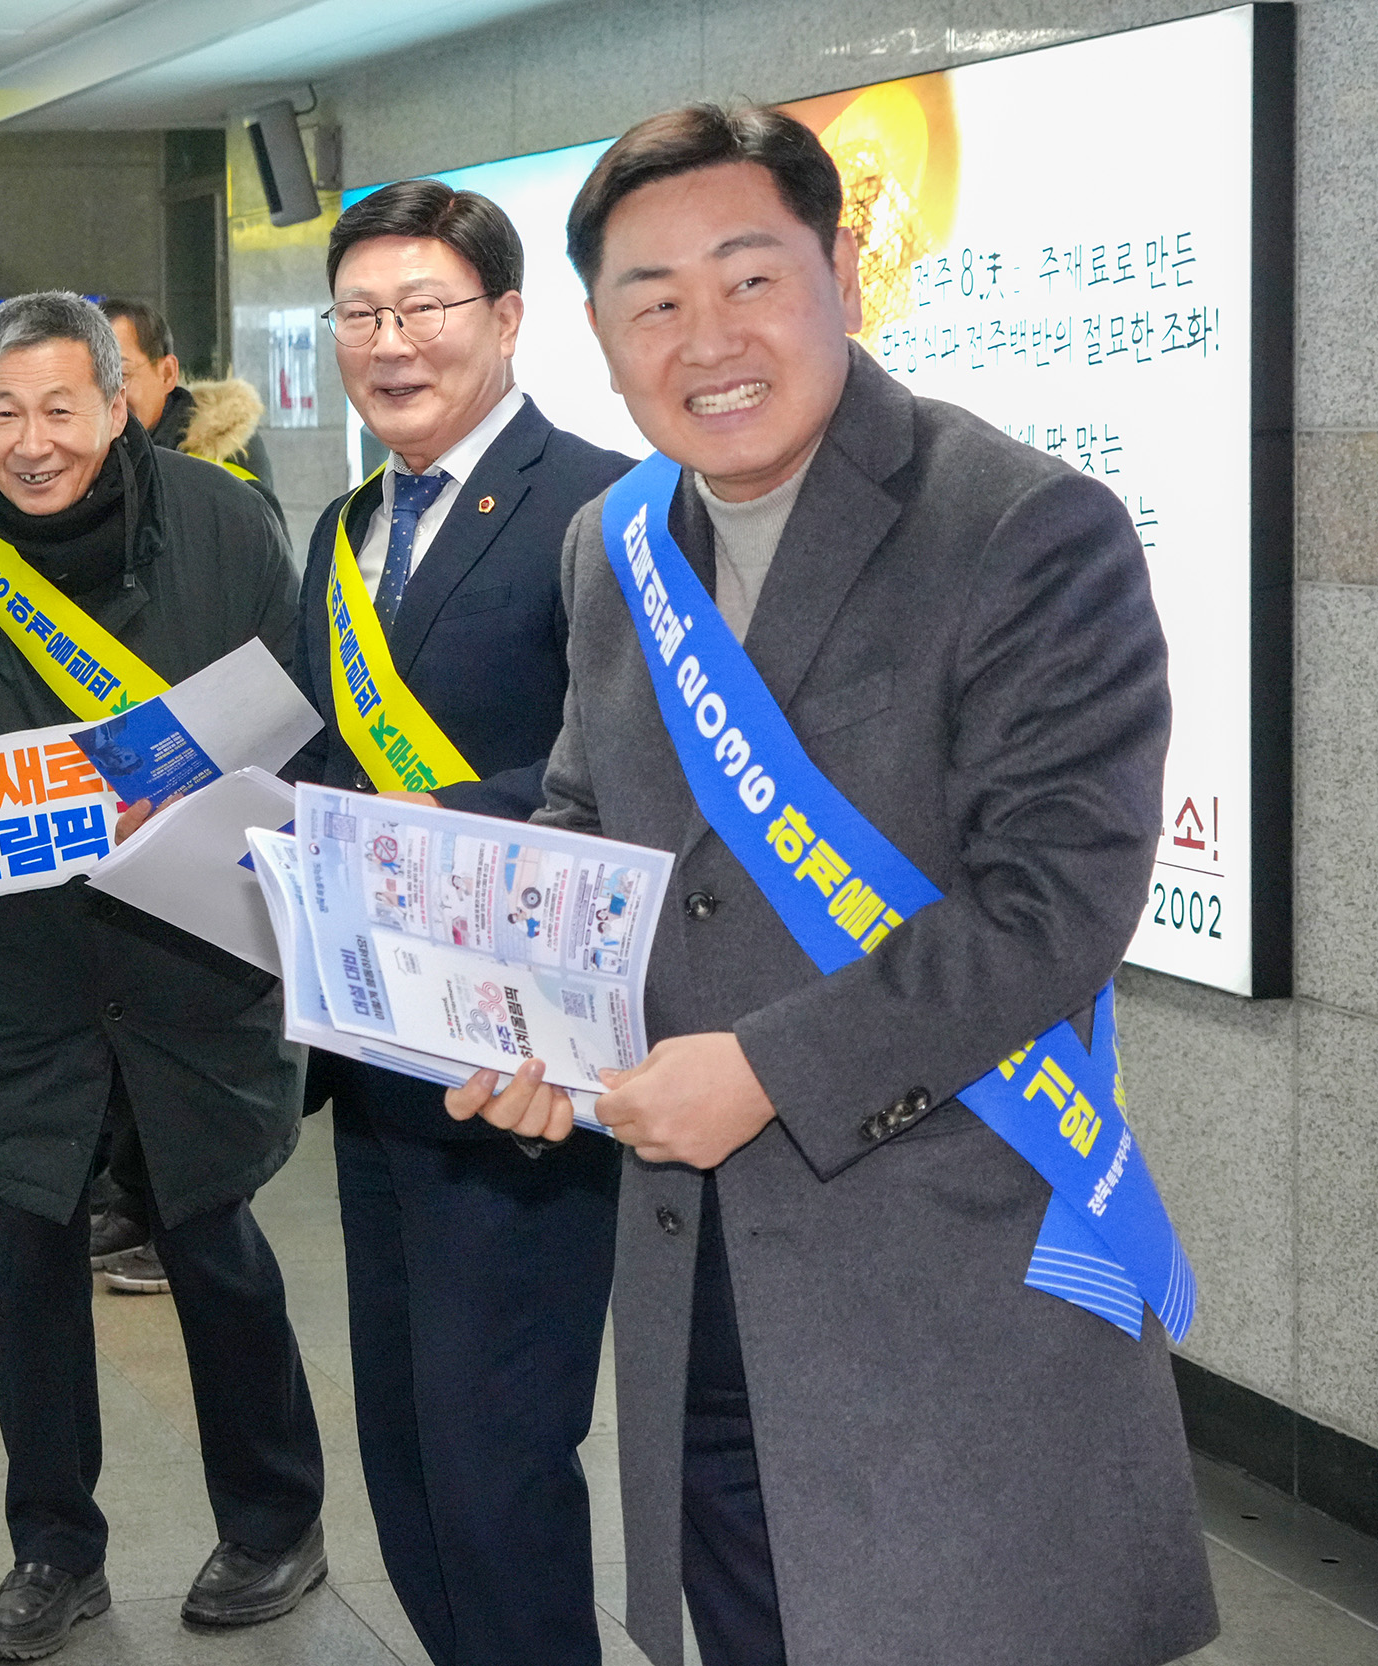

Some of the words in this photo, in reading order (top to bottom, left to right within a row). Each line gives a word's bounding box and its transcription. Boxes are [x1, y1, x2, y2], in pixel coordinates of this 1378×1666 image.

[914, 257, 953, 306] 전주
[1039, 240, 1136, 295] 주재료로
[1146, 231, 1197, 289] 만든
[882, 326, 960, 374] 한정식과
[966, 316, 1072, 370] 전주백반의
[1083, 311, 1155, 366] 절묘한
[1161, 305, 1220, 359] 조화!
[1076, 424, 1124, 475] 맞는
[5, 591, 122, 702] 하계올림픽
[331, 578, 383, 718] 하계올림픽
[677, 655, 776, 815] 2036
[1161, 796, 1219, 862] 소!
[1023, 1055, 1103, 1159] 기원
